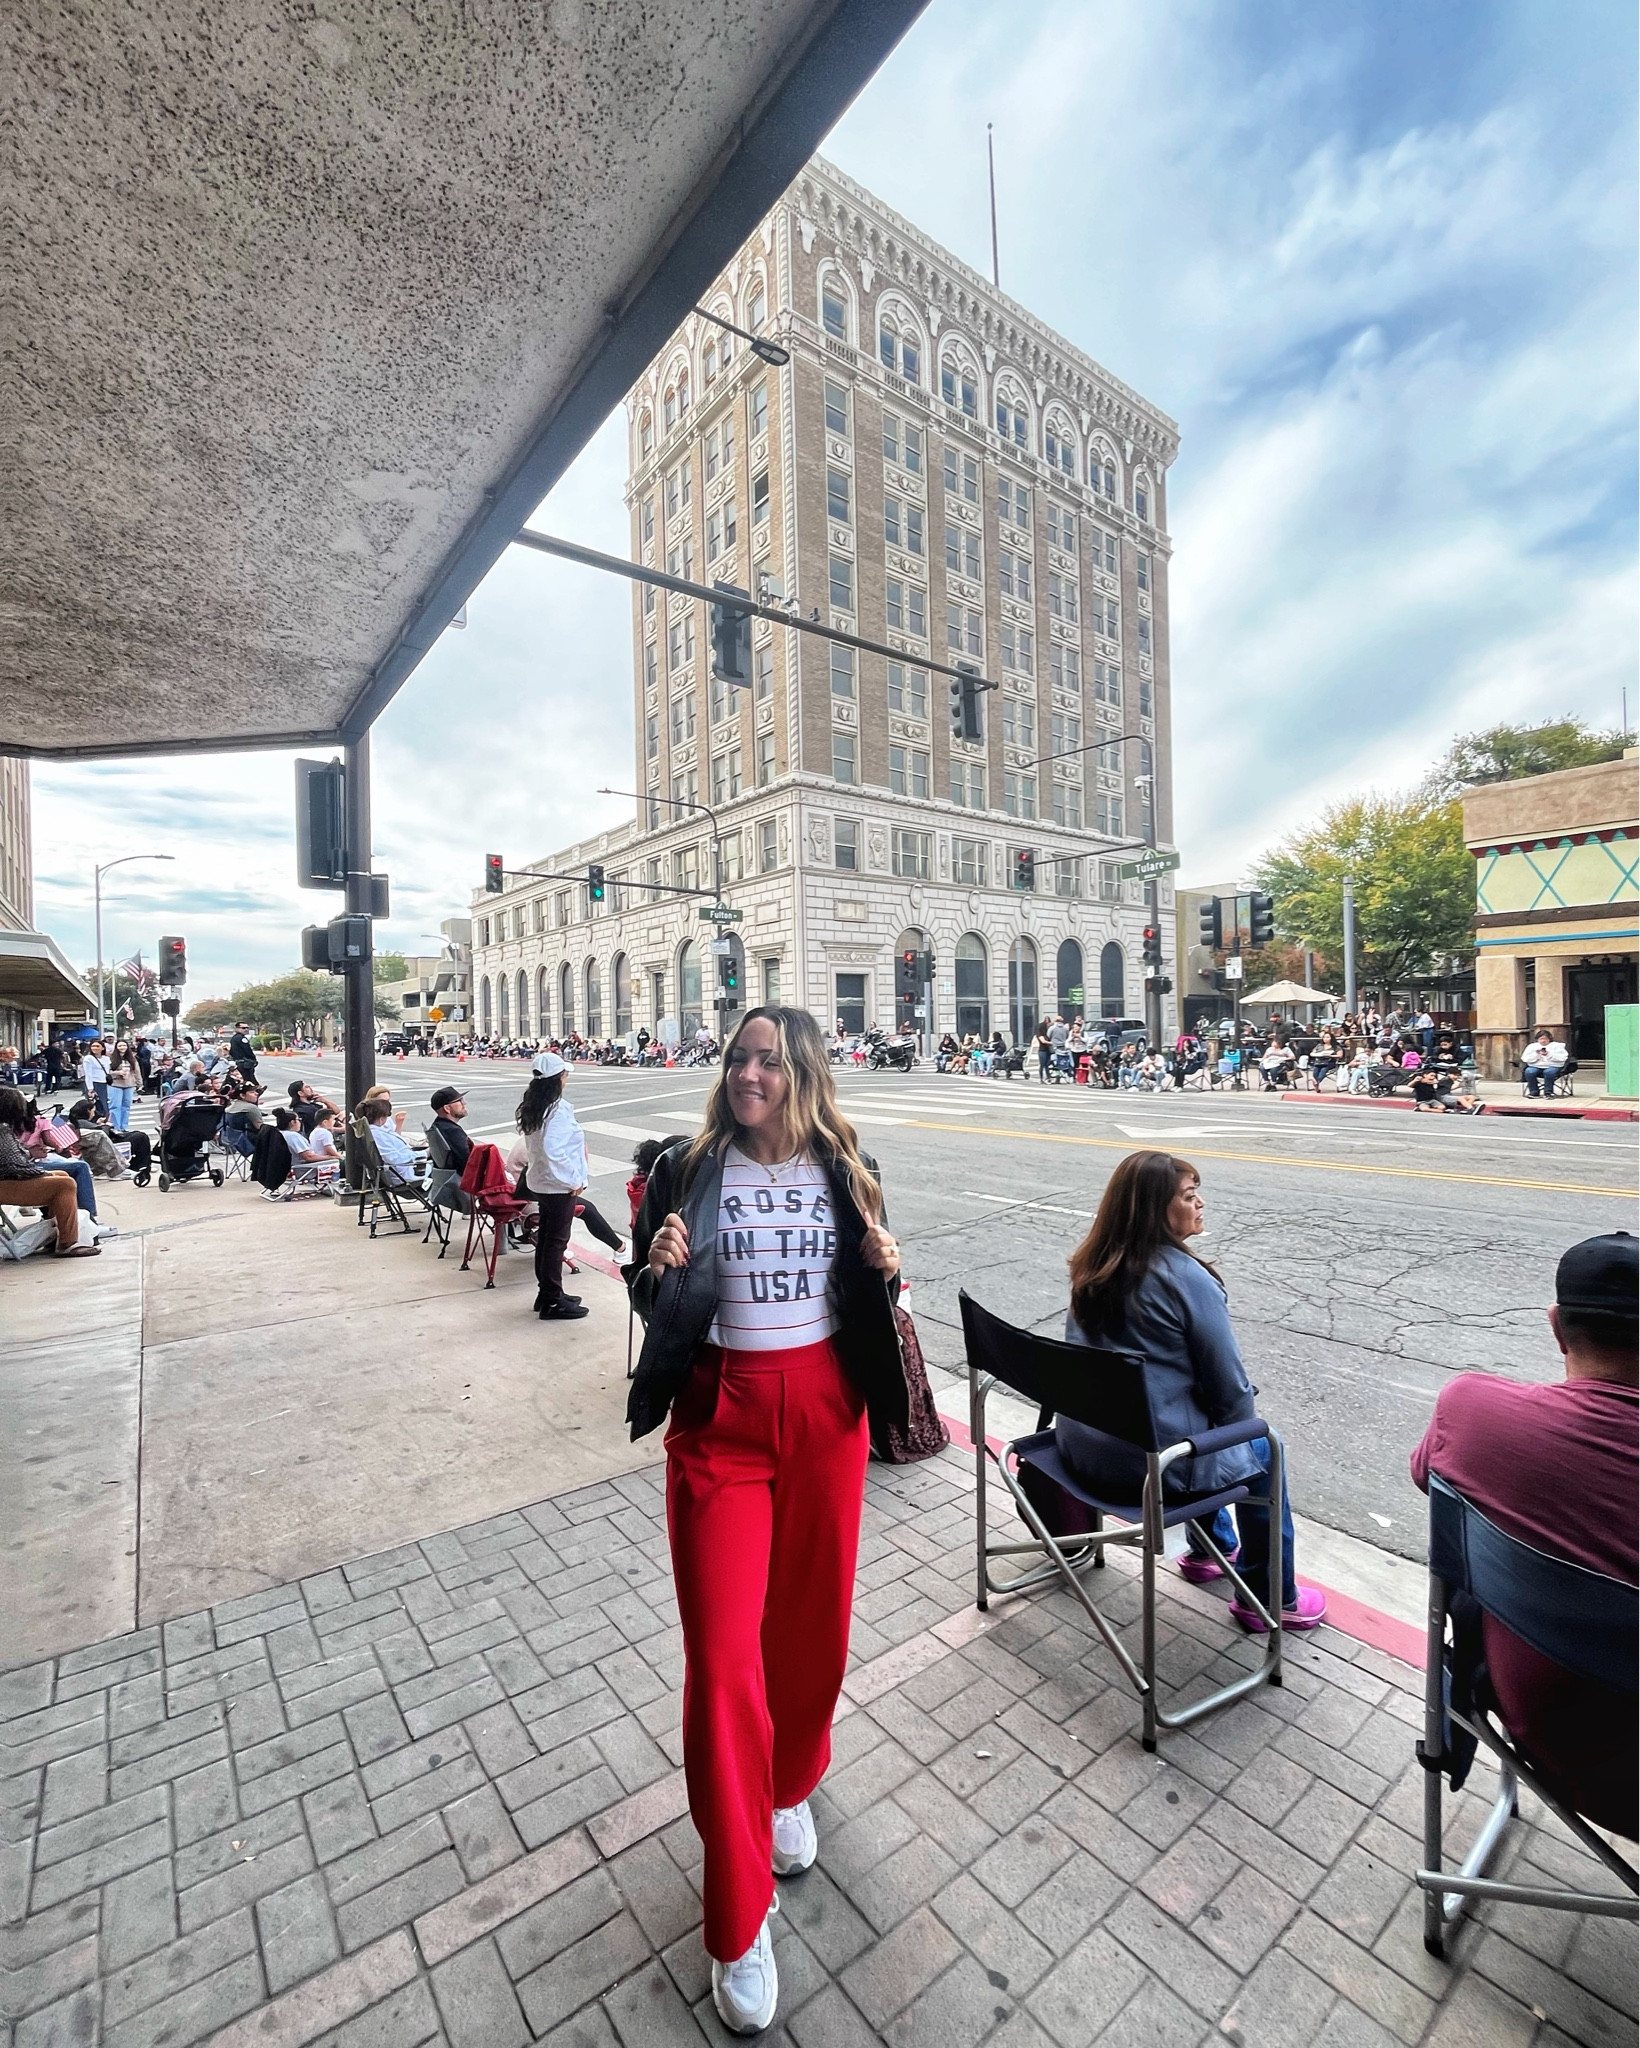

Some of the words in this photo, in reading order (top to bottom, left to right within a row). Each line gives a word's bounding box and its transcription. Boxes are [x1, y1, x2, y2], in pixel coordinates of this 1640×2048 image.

[1135, 861, 1165, 874] Tulare
[710, 910, 733, 919] Fulton
[722, 1230, 756, 1261] IN
[775, 1229, 837, 1258] THE
[749, 1269, 811, 1303] USA
